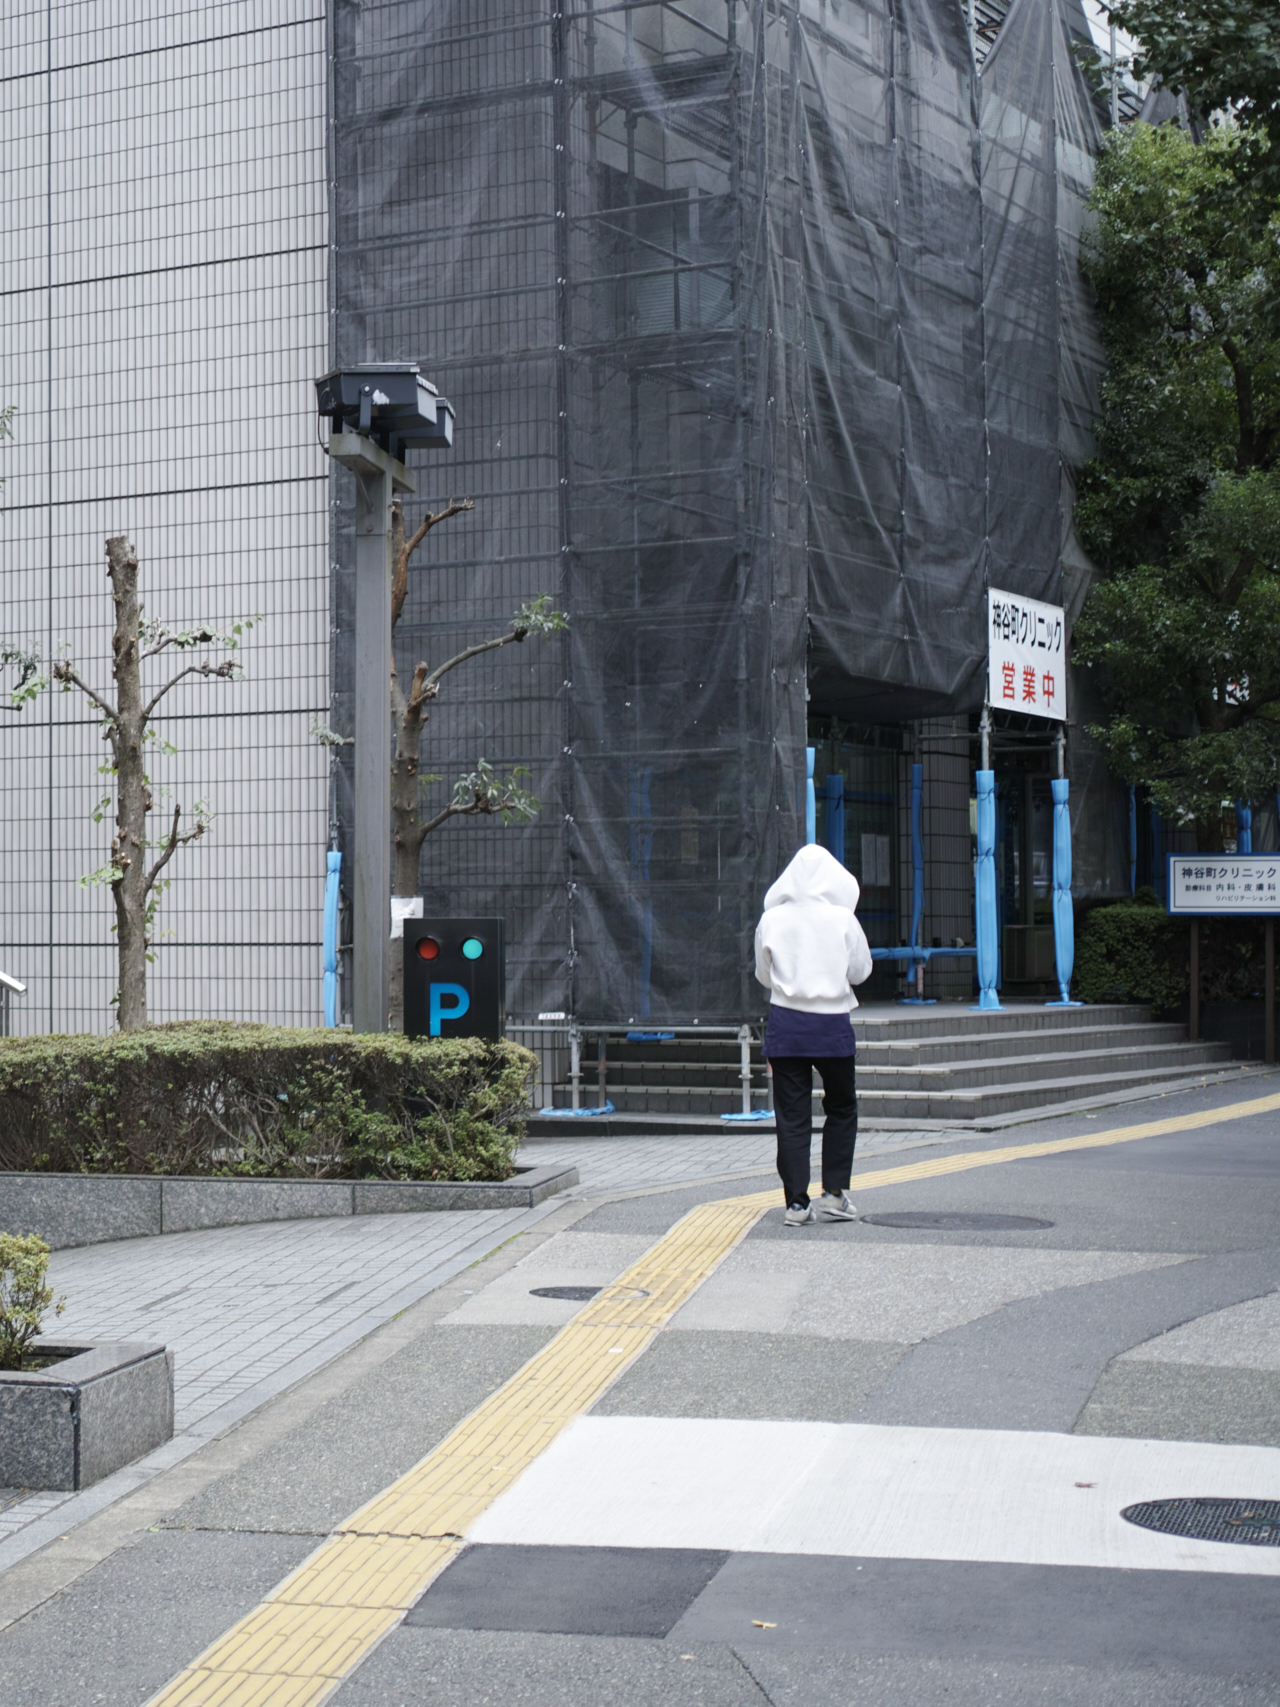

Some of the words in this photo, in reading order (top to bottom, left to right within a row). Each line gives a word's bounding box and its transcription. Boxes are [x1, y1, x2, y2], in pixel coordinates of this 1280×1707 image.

[992, 599, 1061, 653] 神谷町クリニック
[1002, 661, 1055, 708] 営業中
[1181, 867, 1277, 879] 神谷町クリニック
[429, 982, 470, 1036] P
